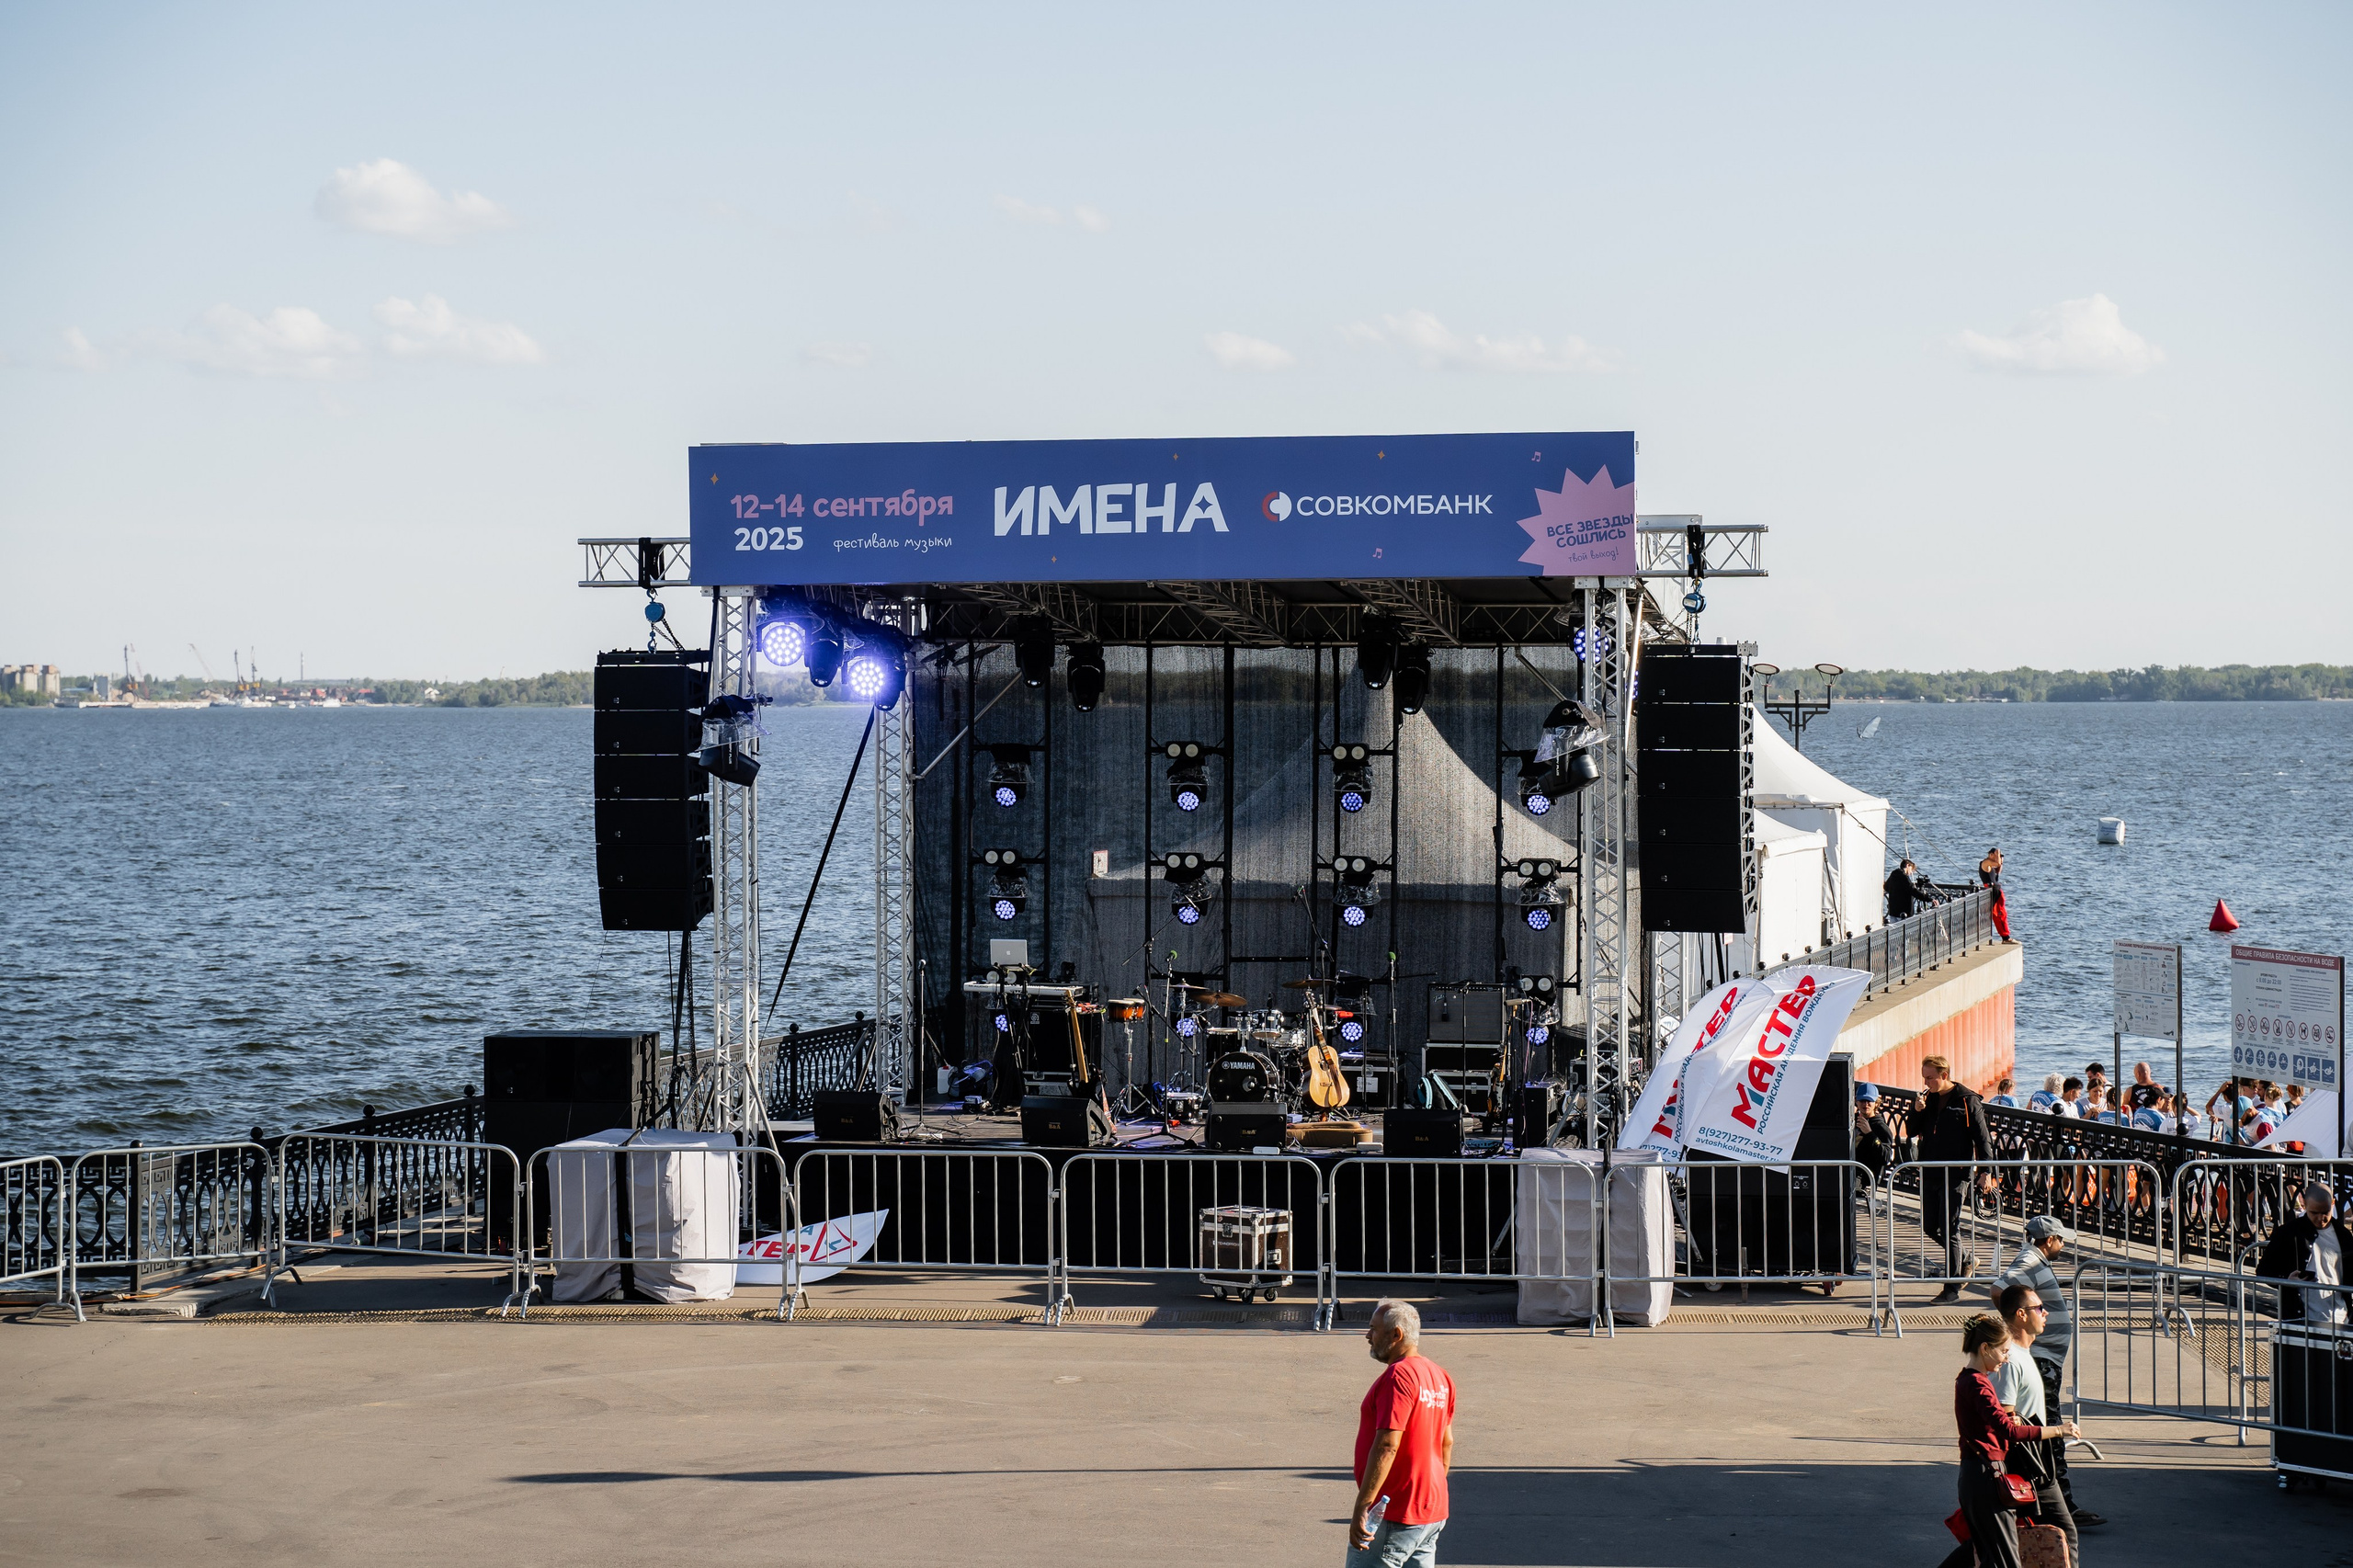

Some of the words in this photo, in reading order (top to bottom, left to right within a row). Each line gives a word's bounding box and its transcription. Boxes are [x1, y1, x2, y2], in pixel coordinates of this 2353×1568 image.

[813, 488, 953, 526] сентября
[994, 482, 1229, 536] ИМЕНА
[1296, 494, 1494, 517] СОВКОМБАНК
[1547, 523, 1574, 537] ВСЕ
[1577, 514, 1634, 532] ЗВЕЗДЫ
[734, 527, 803, 551] 2025
[833, 533, 900, 551] фестиваль
[904, 536, 953, 553] музыки
[1556, 528, 1627, 548] СОШЛИСЬ
[1568, 552, 1588, 562] твой
[1590, 547, 1620, 561] выход!
[2235, 949, 2253, 958] ОБЩИЕ
[2253, 950, 2275, 960] ПРАВИЛА
[2275, 953, 2313, 964] БЕЗОПАСНОСТИ
[2313, 957, 2321, 965] НА
[2321, 959, 2335, 967] ВОДЕ
[1731, 974, 1816, 1130] МАСТЕР
[1230, 1062, 1256, 1070] YAMAHA
[1756, 1072, 1784, 1135] РОССИЙСКАЯ
[1782, 1023, 1806, 1073] АКАДЕМИЯ
[1699, 1126, 1784, 1155] 8(927)277-93-77
